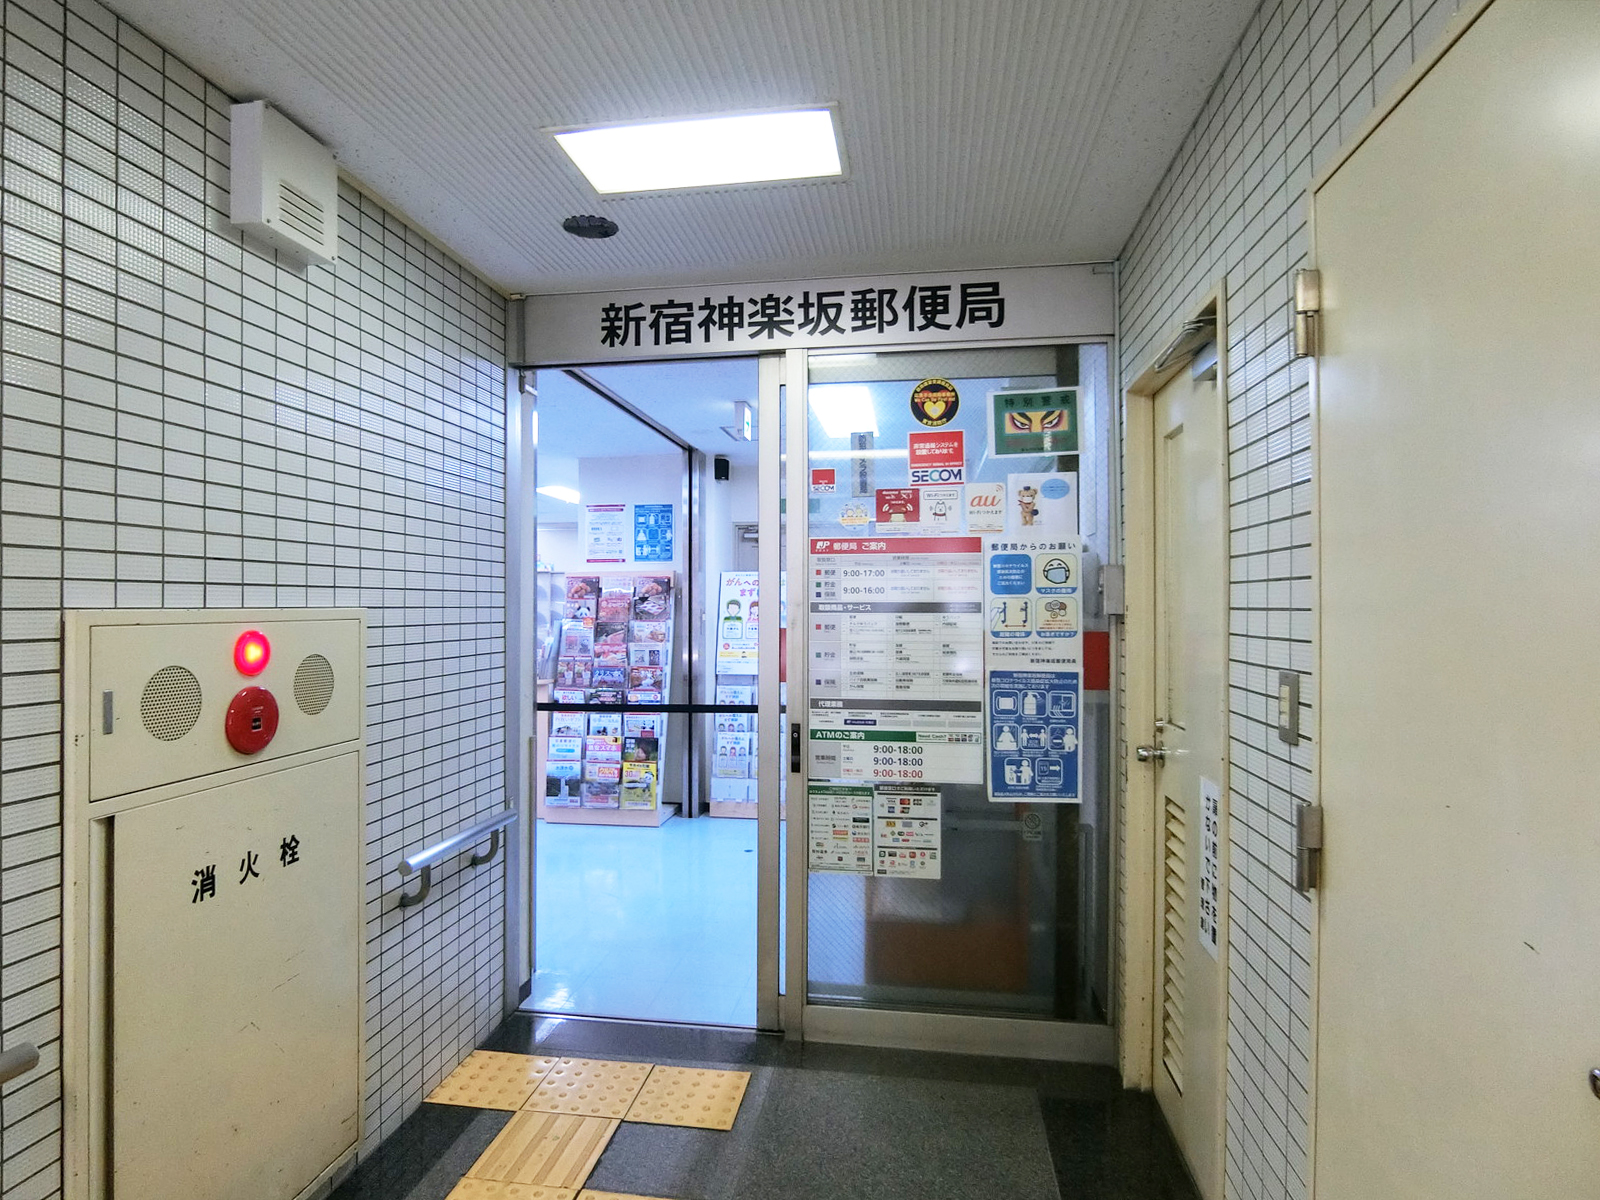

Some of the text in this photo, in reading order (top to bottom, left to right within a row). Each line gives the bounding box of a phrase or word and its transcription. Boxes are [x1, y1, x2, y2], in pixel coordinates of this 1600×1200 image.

[601, 282, 1006, 347] 新宿神楽坂郵便局
[912, 469, 962, 482] SECOM
[970, 495, 1001, 507] au
[833, 542, 886, 550] 郵便局 ご案内
[991, 542, 1076, 551] 郵便局からのお願い
[843, 569, 885, 578] 9:00-17:00
[740, 588, 759, 597] まず
[843, 587, 885, 595] 9:00-16:00
[815, 731, 865, 740] ATMのご案内
[873, 745, 923, 754] 9:00-18:00
[873, 757, 923, 766] 9:00-18:00
[873, 769, 923, 778] 9:00-18:00
[191, 834, 300, 904] 消火栓
